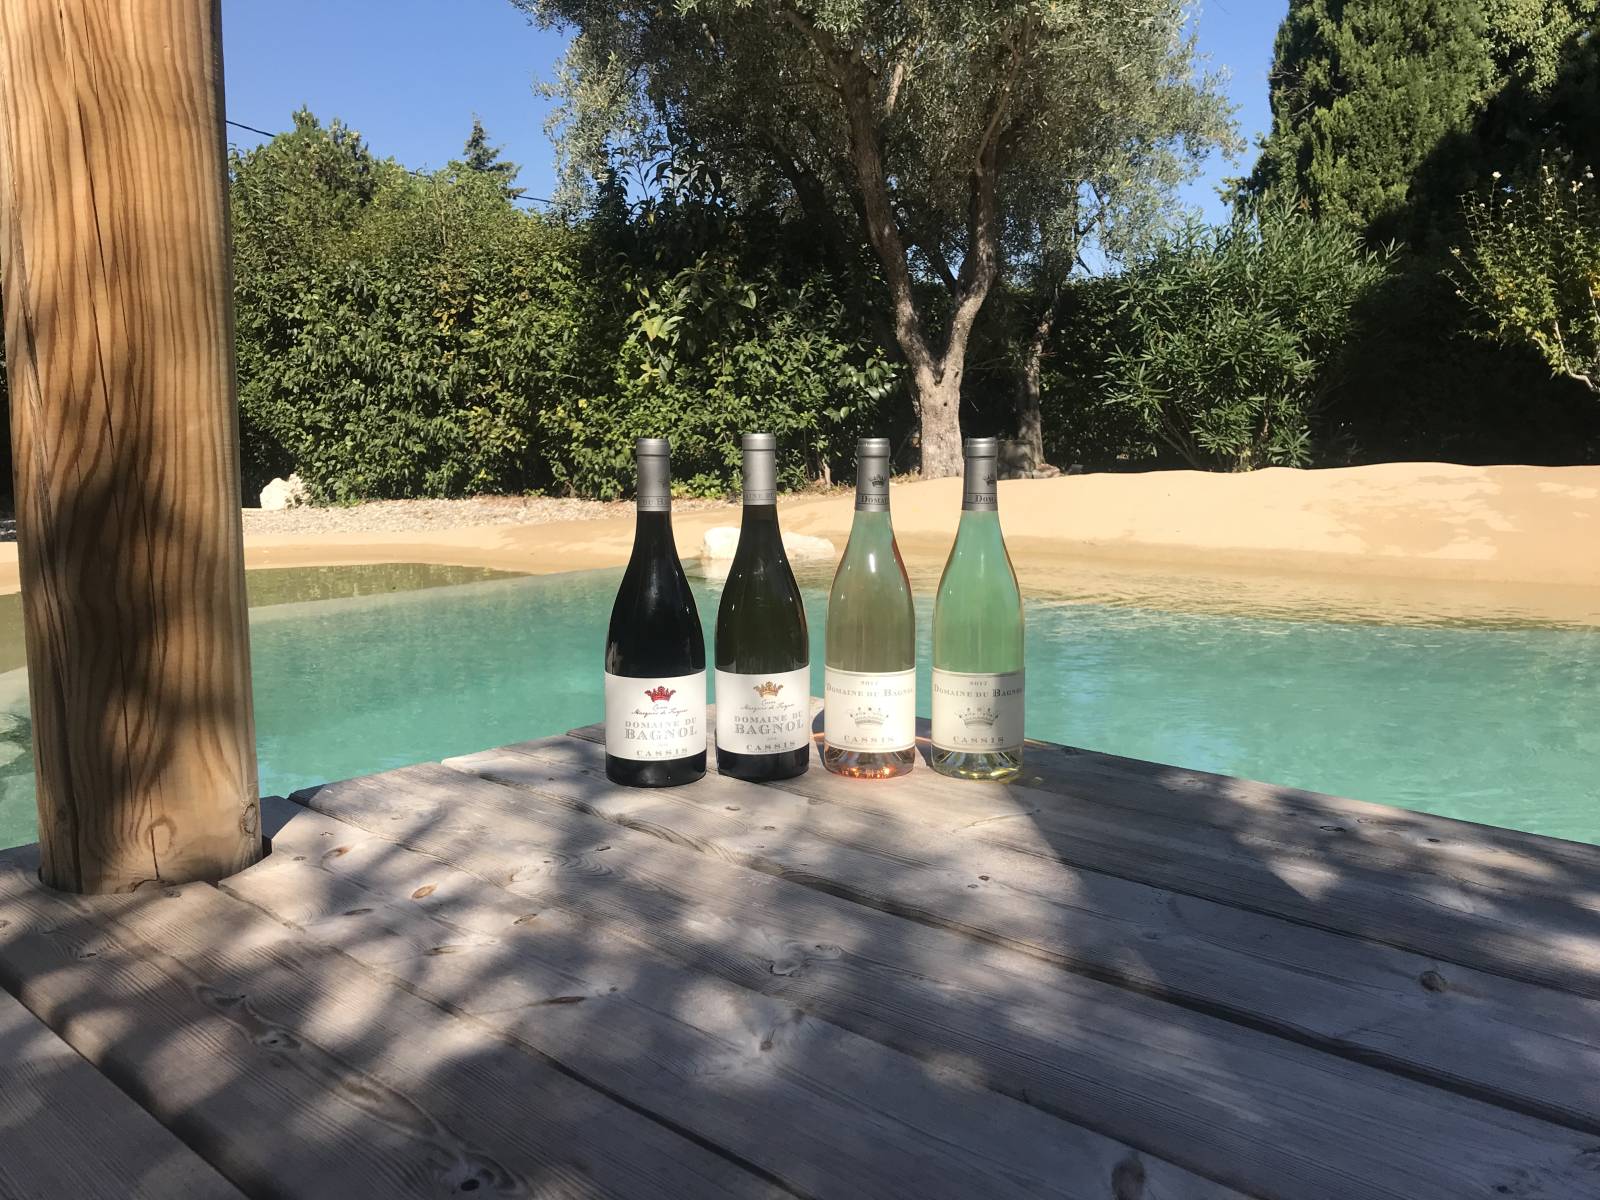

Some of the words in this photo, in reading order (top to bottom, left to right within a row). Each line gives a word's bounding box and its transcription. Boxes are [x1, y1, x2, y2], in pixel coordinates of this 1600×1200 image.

[826, 682, 864, 697] DOMAINE
[934, 683, 973, 697] DOMAINE
[624, 719, 680, 729] DOMAINE
[685, 717, 697, 726] DU
[734, 715, 788, 724] DOMAINE
[735, 720, 804, 735] BAGNOL
[624, 725, 698, 741] BAGNOL
[844, 735, 895, 744] CASSIS
[953, 736, 1004, 745] CASSIS
[746, 742, 796, 751] CASSIS
[636, 748, 688, 757] CASSIS
